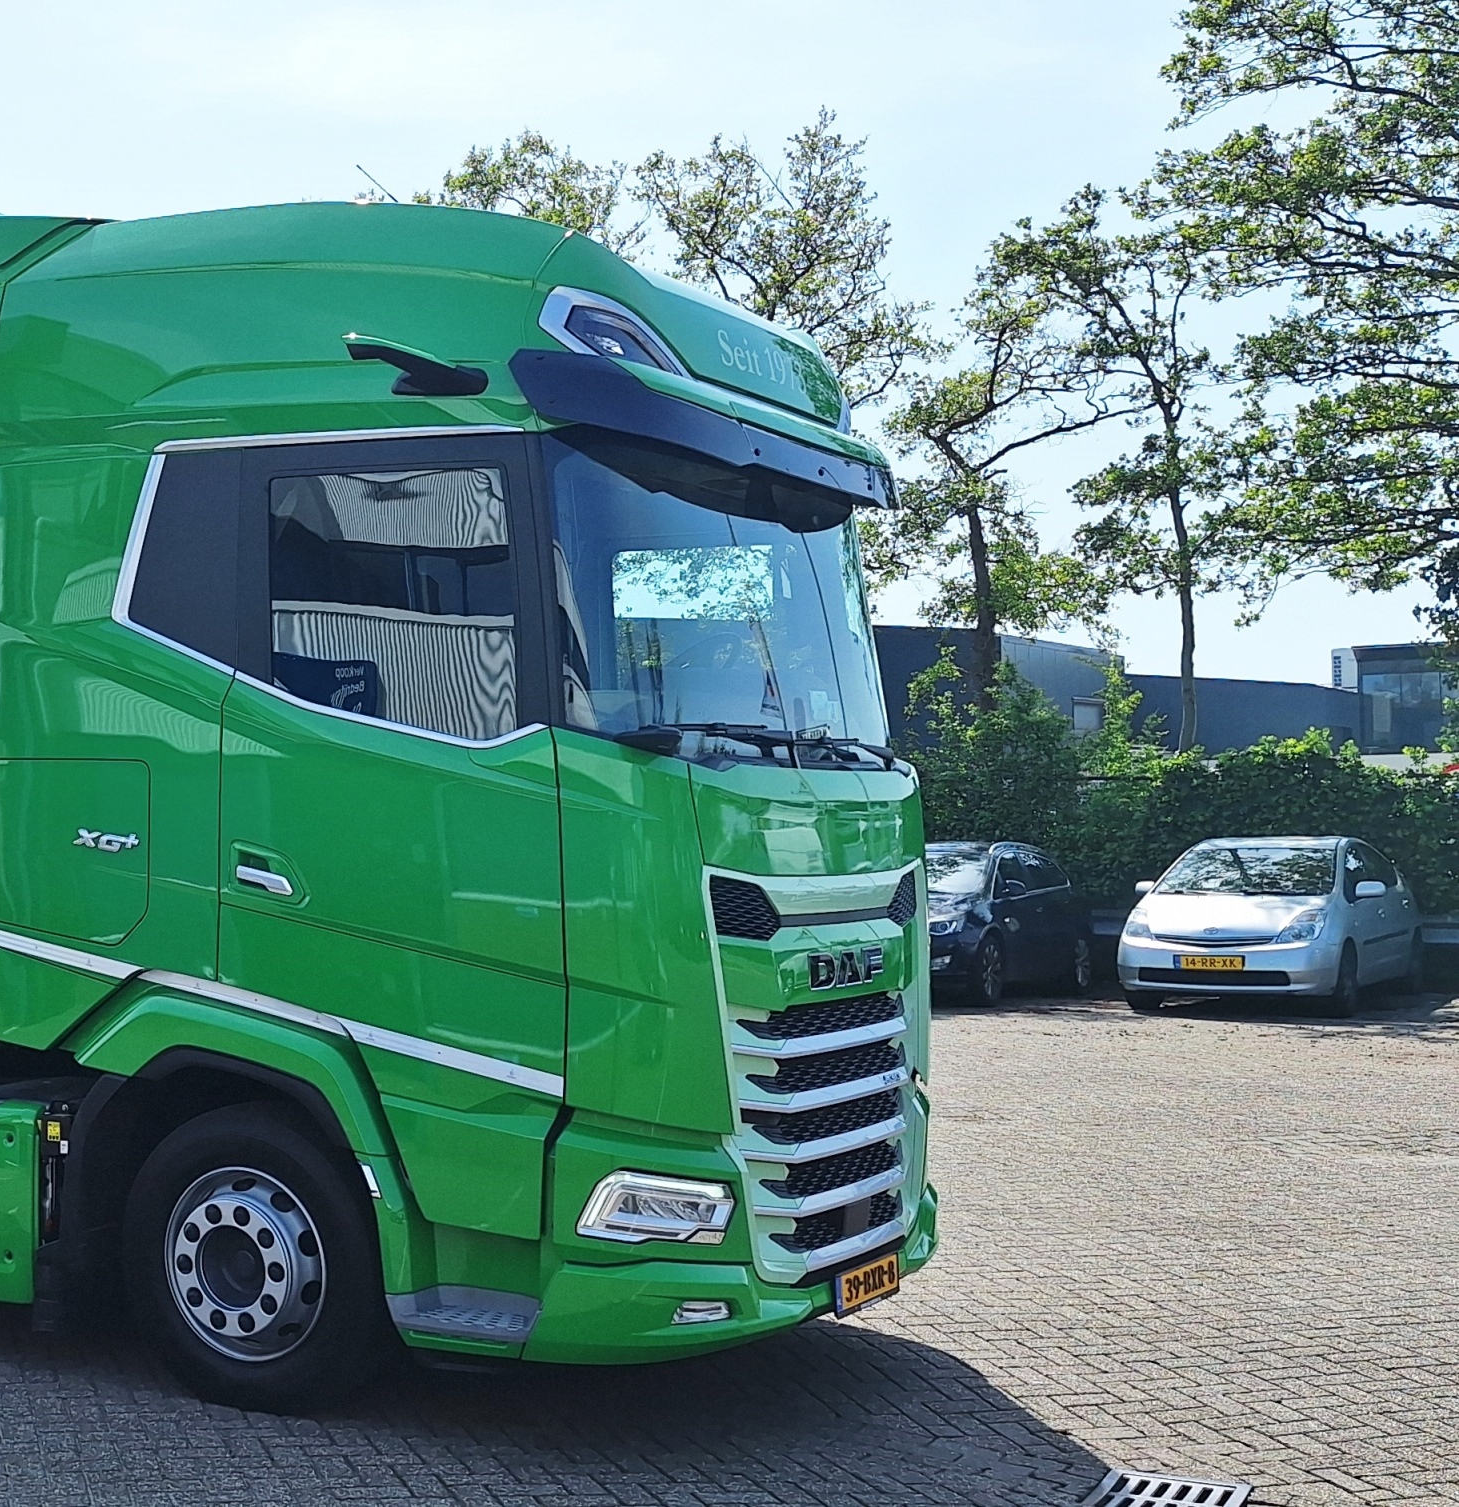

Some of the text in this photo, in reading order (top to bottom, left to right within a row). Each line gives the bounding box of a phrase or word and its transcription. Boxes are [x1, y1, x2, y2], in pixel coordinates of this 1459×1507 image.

[717, 329, 762, 377] Seit
[72, 827, 140, 853] XG+
[806, 944, 885, 992] DAF
[1184, 957, 1237, 968] 14-RR-XK
[845, 1260, 896, 1303] 39-BXR-8
